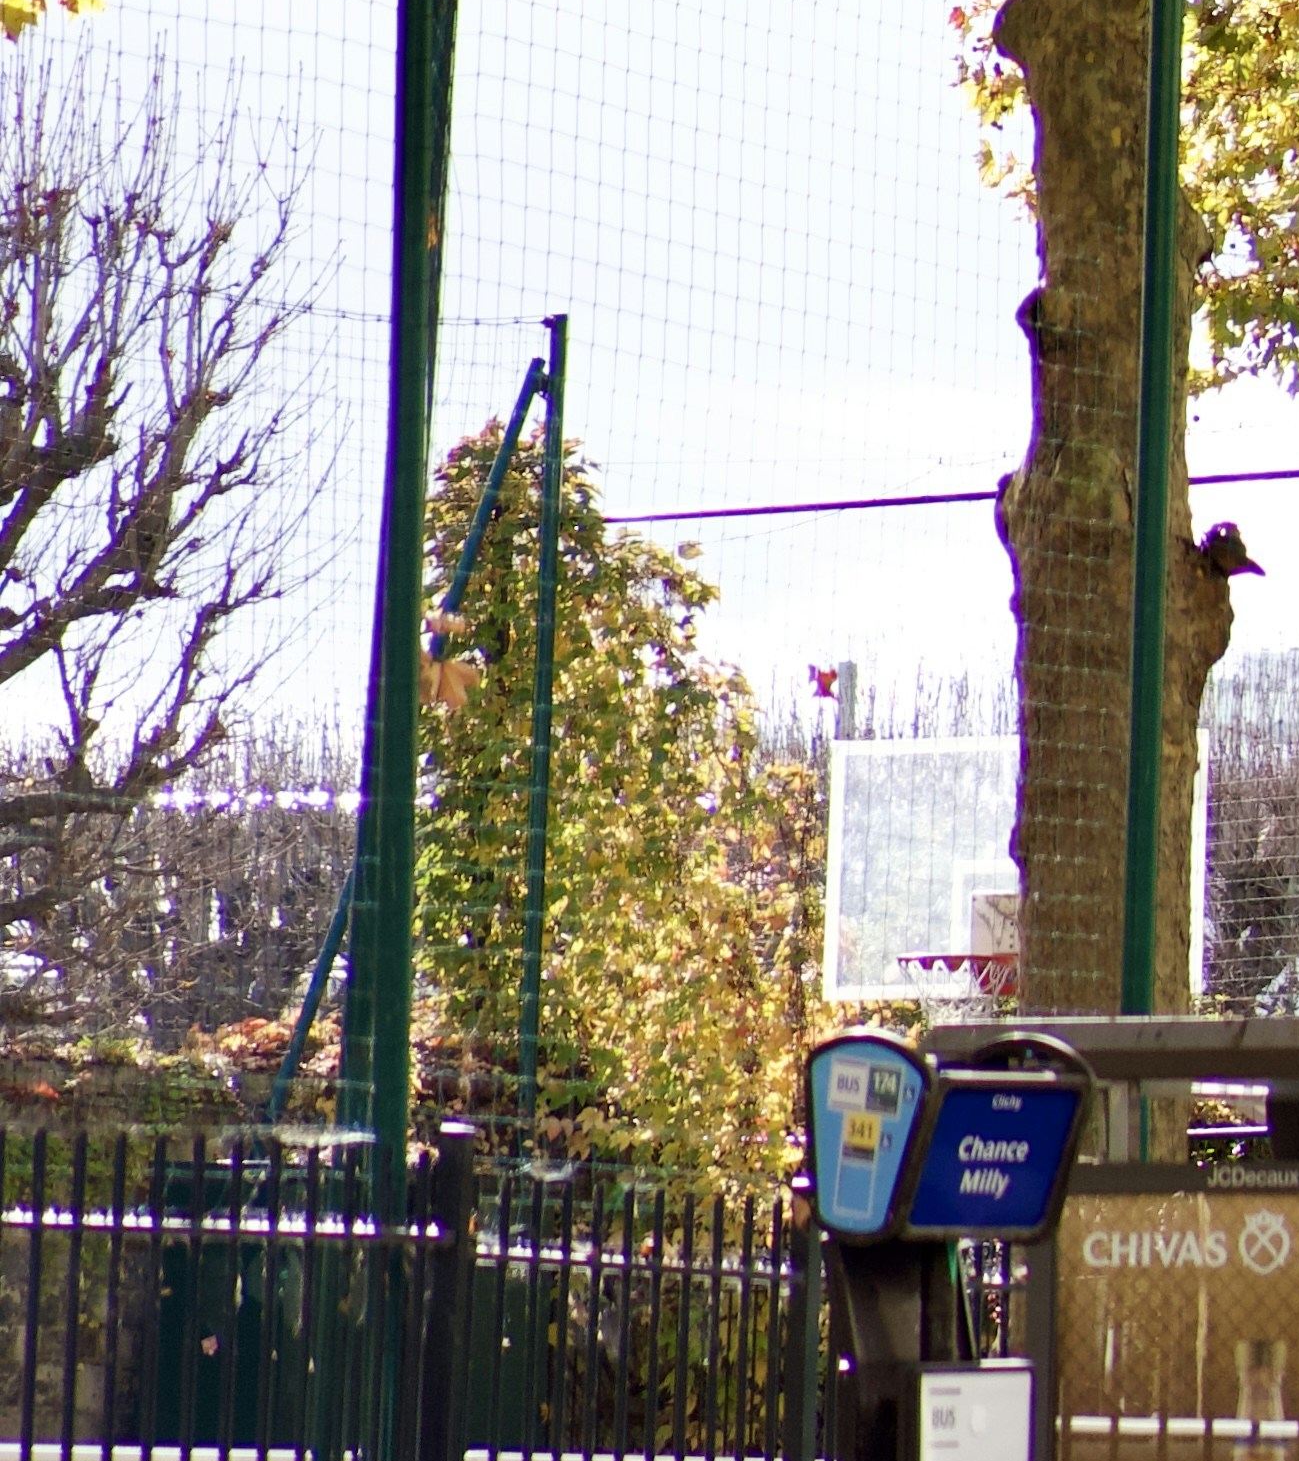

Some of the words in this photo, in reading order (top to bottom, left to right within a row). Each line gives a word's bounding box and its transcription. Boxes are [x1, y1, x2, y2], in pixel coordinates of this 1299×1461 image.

[837, 1074, 860, 1093] BUS
[873, 1072, 897, 1095] 174
[991, 1094, 1022, 1112] Clichy
[850, 1119, 872, 1139] 341
[959, 1136, 1028, 1162] Chance
[960, 1169, 1008, 1199] Milly
[1207, 1165, 1299, 1188] JCDecaux
[1082, 1230, 1228, 1269] CHIVAS
[932, 1408, 955, 1430] BUS
